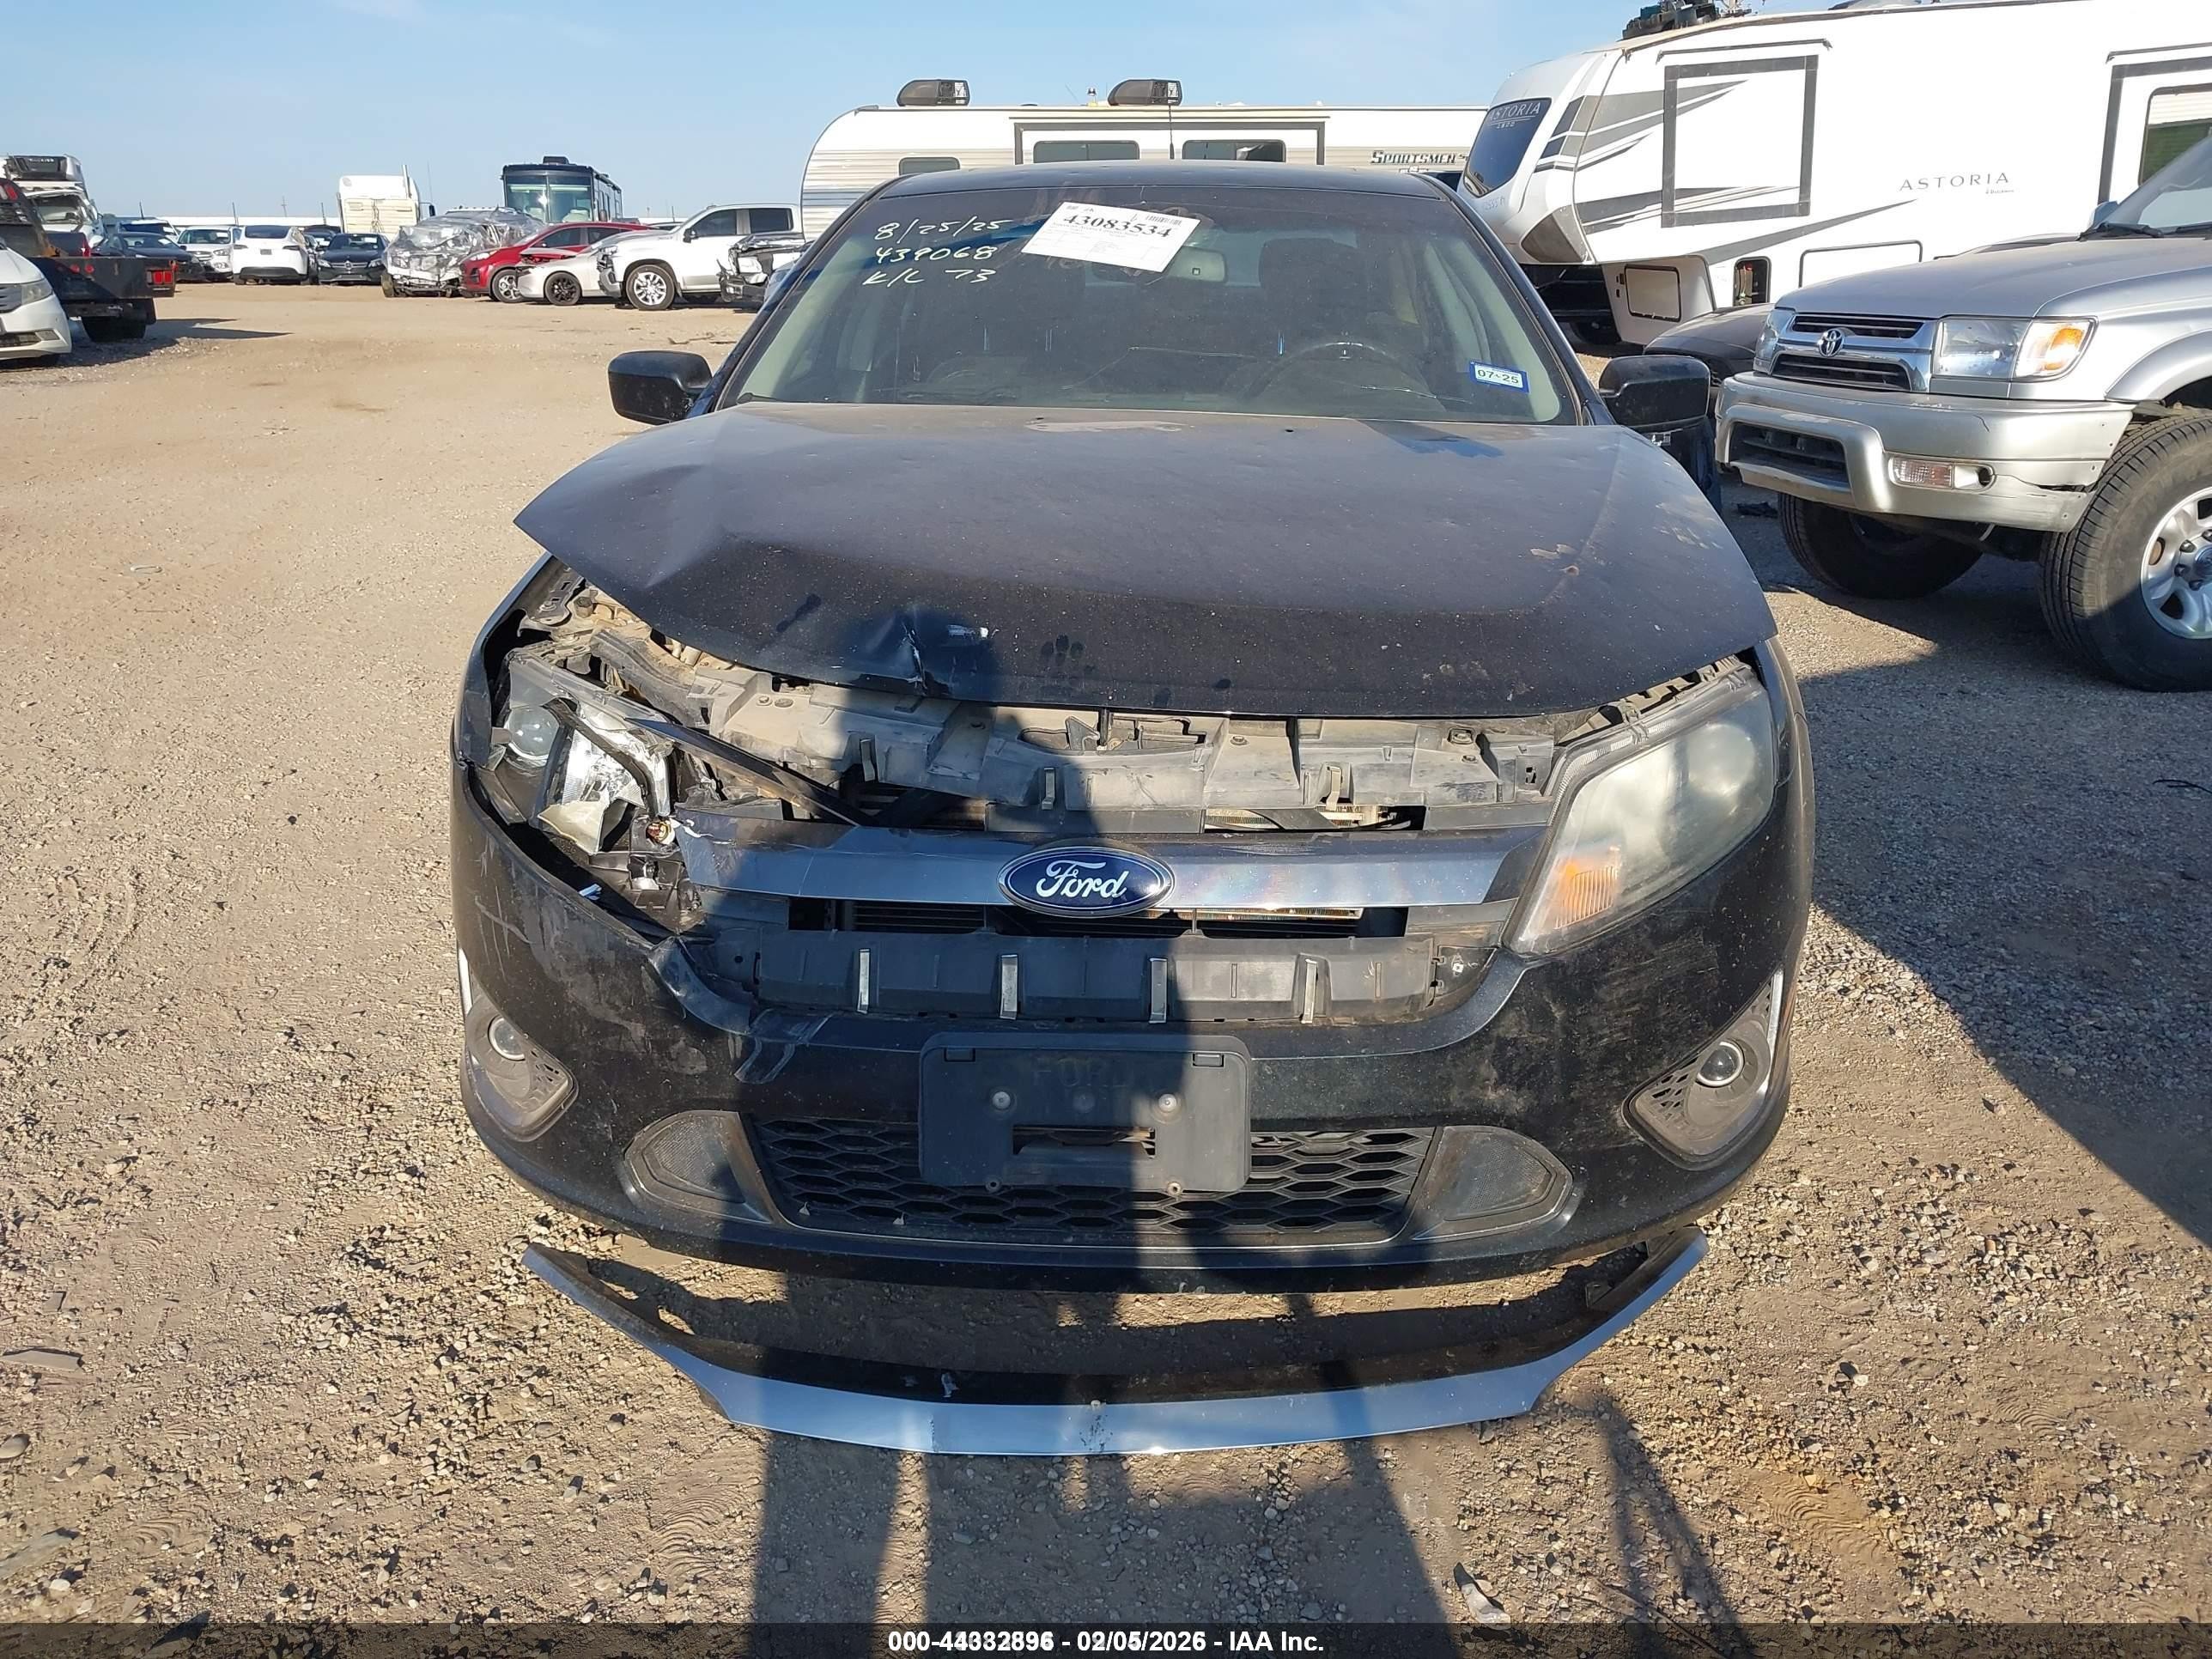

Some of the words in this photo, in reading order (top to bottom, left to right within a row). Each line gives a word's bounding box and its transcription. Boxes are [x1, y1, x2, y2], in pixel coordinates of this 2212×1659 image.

[1489, 102, 1541, 121] ASTORIA
[1370, 150, 1456, 164] SPORTSMEN
[1899, 173, 2008, 191] ASTORIA
[874, 216, 1014, 244] 8/25/25
[1063, 214, 1173, 238] 43083534
[876, 246, 998, 264] 439068
[1036, 860, 1130, 898] Ford
